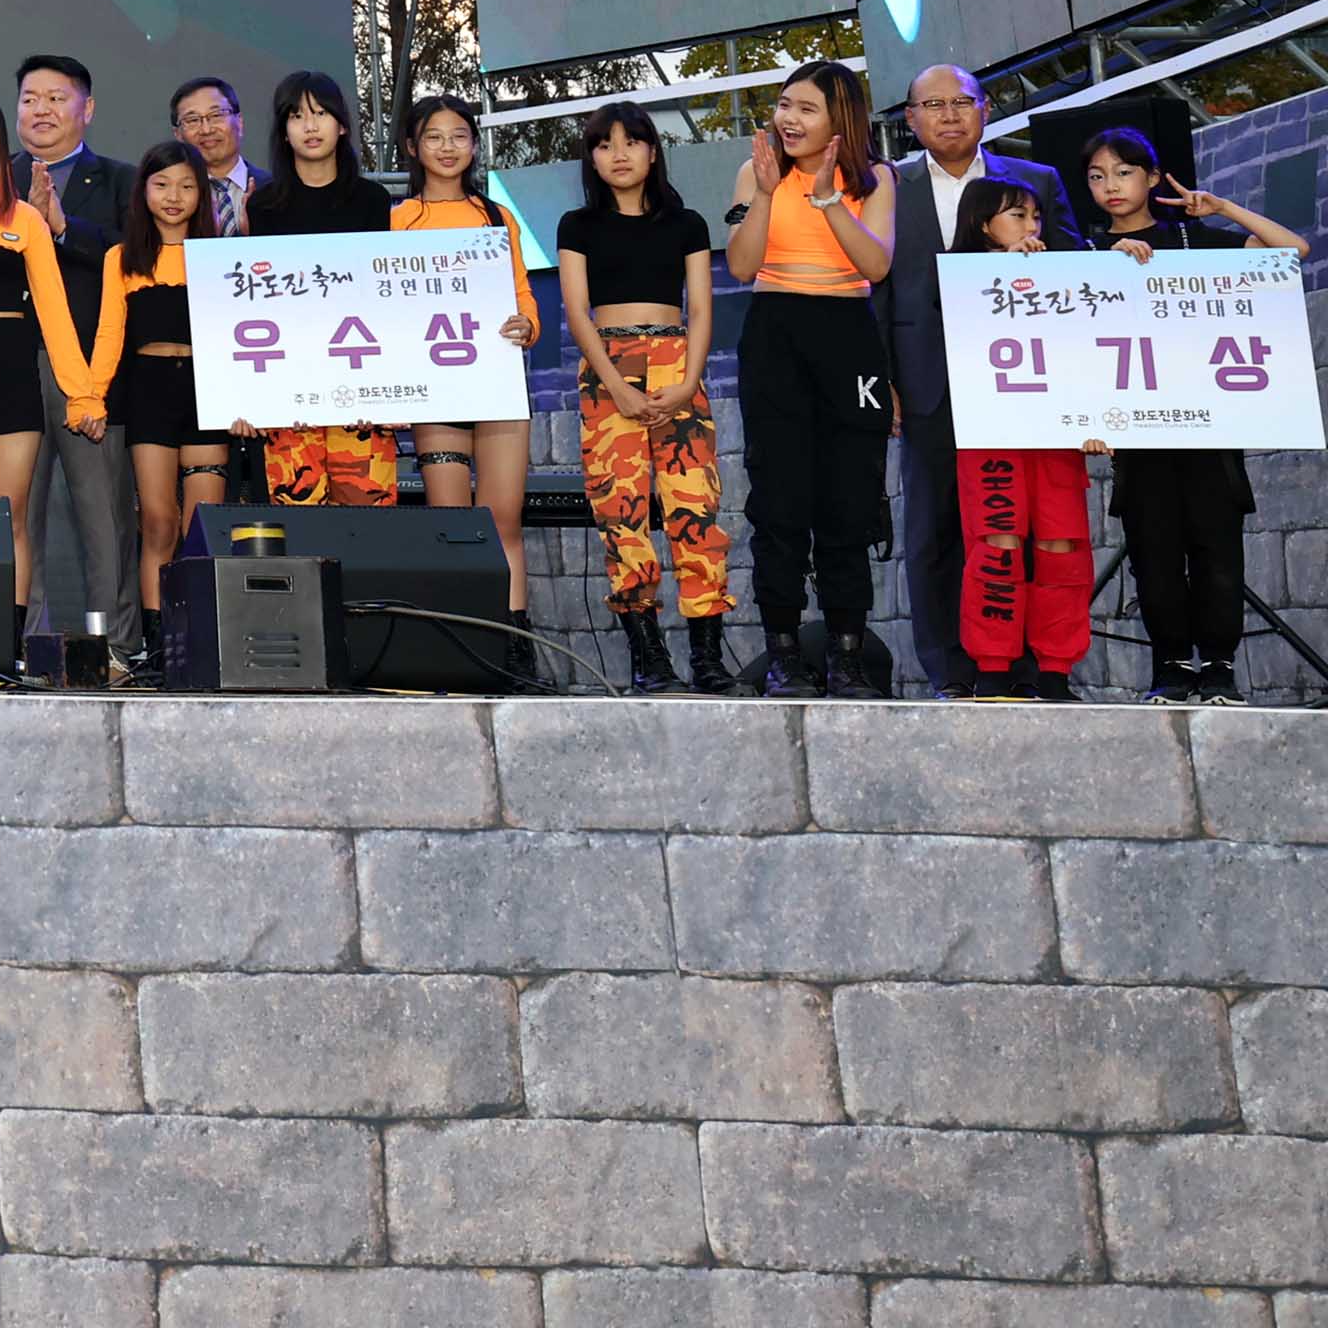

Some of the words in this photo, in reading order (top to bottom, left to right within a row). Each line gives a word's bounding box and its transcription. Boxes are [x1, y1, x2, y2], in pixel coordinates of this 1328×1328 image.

[223, 261, 309, 301] 화도진
[311, 264, 353, 298] 축제
[372, 256, 426, 275] 어린이
[432, 254, 467, 273] 댄스
[376, 276, 468, 298] 경연대회
[981, 277, 1076, 319] 화도진
[1078, 282, 1125, 318] 축제
[1146, 276, 1206, 295] 어린이
[1213, 275, 1253, 295] 댄스
[1150, 298, 1253, 319] 경연대회
[232, 312, 481, 373] 우수상
[988, 335, 1272, 393] 인기상
[358, 384, 429, 398] 화도진문화원
[857, 375, 881, 409] K
[1132, 409, 1211, 422] 화도진문화원
[980, 458, 1016, 532] SHOW
[980, 549, 1016, 622] TIME
